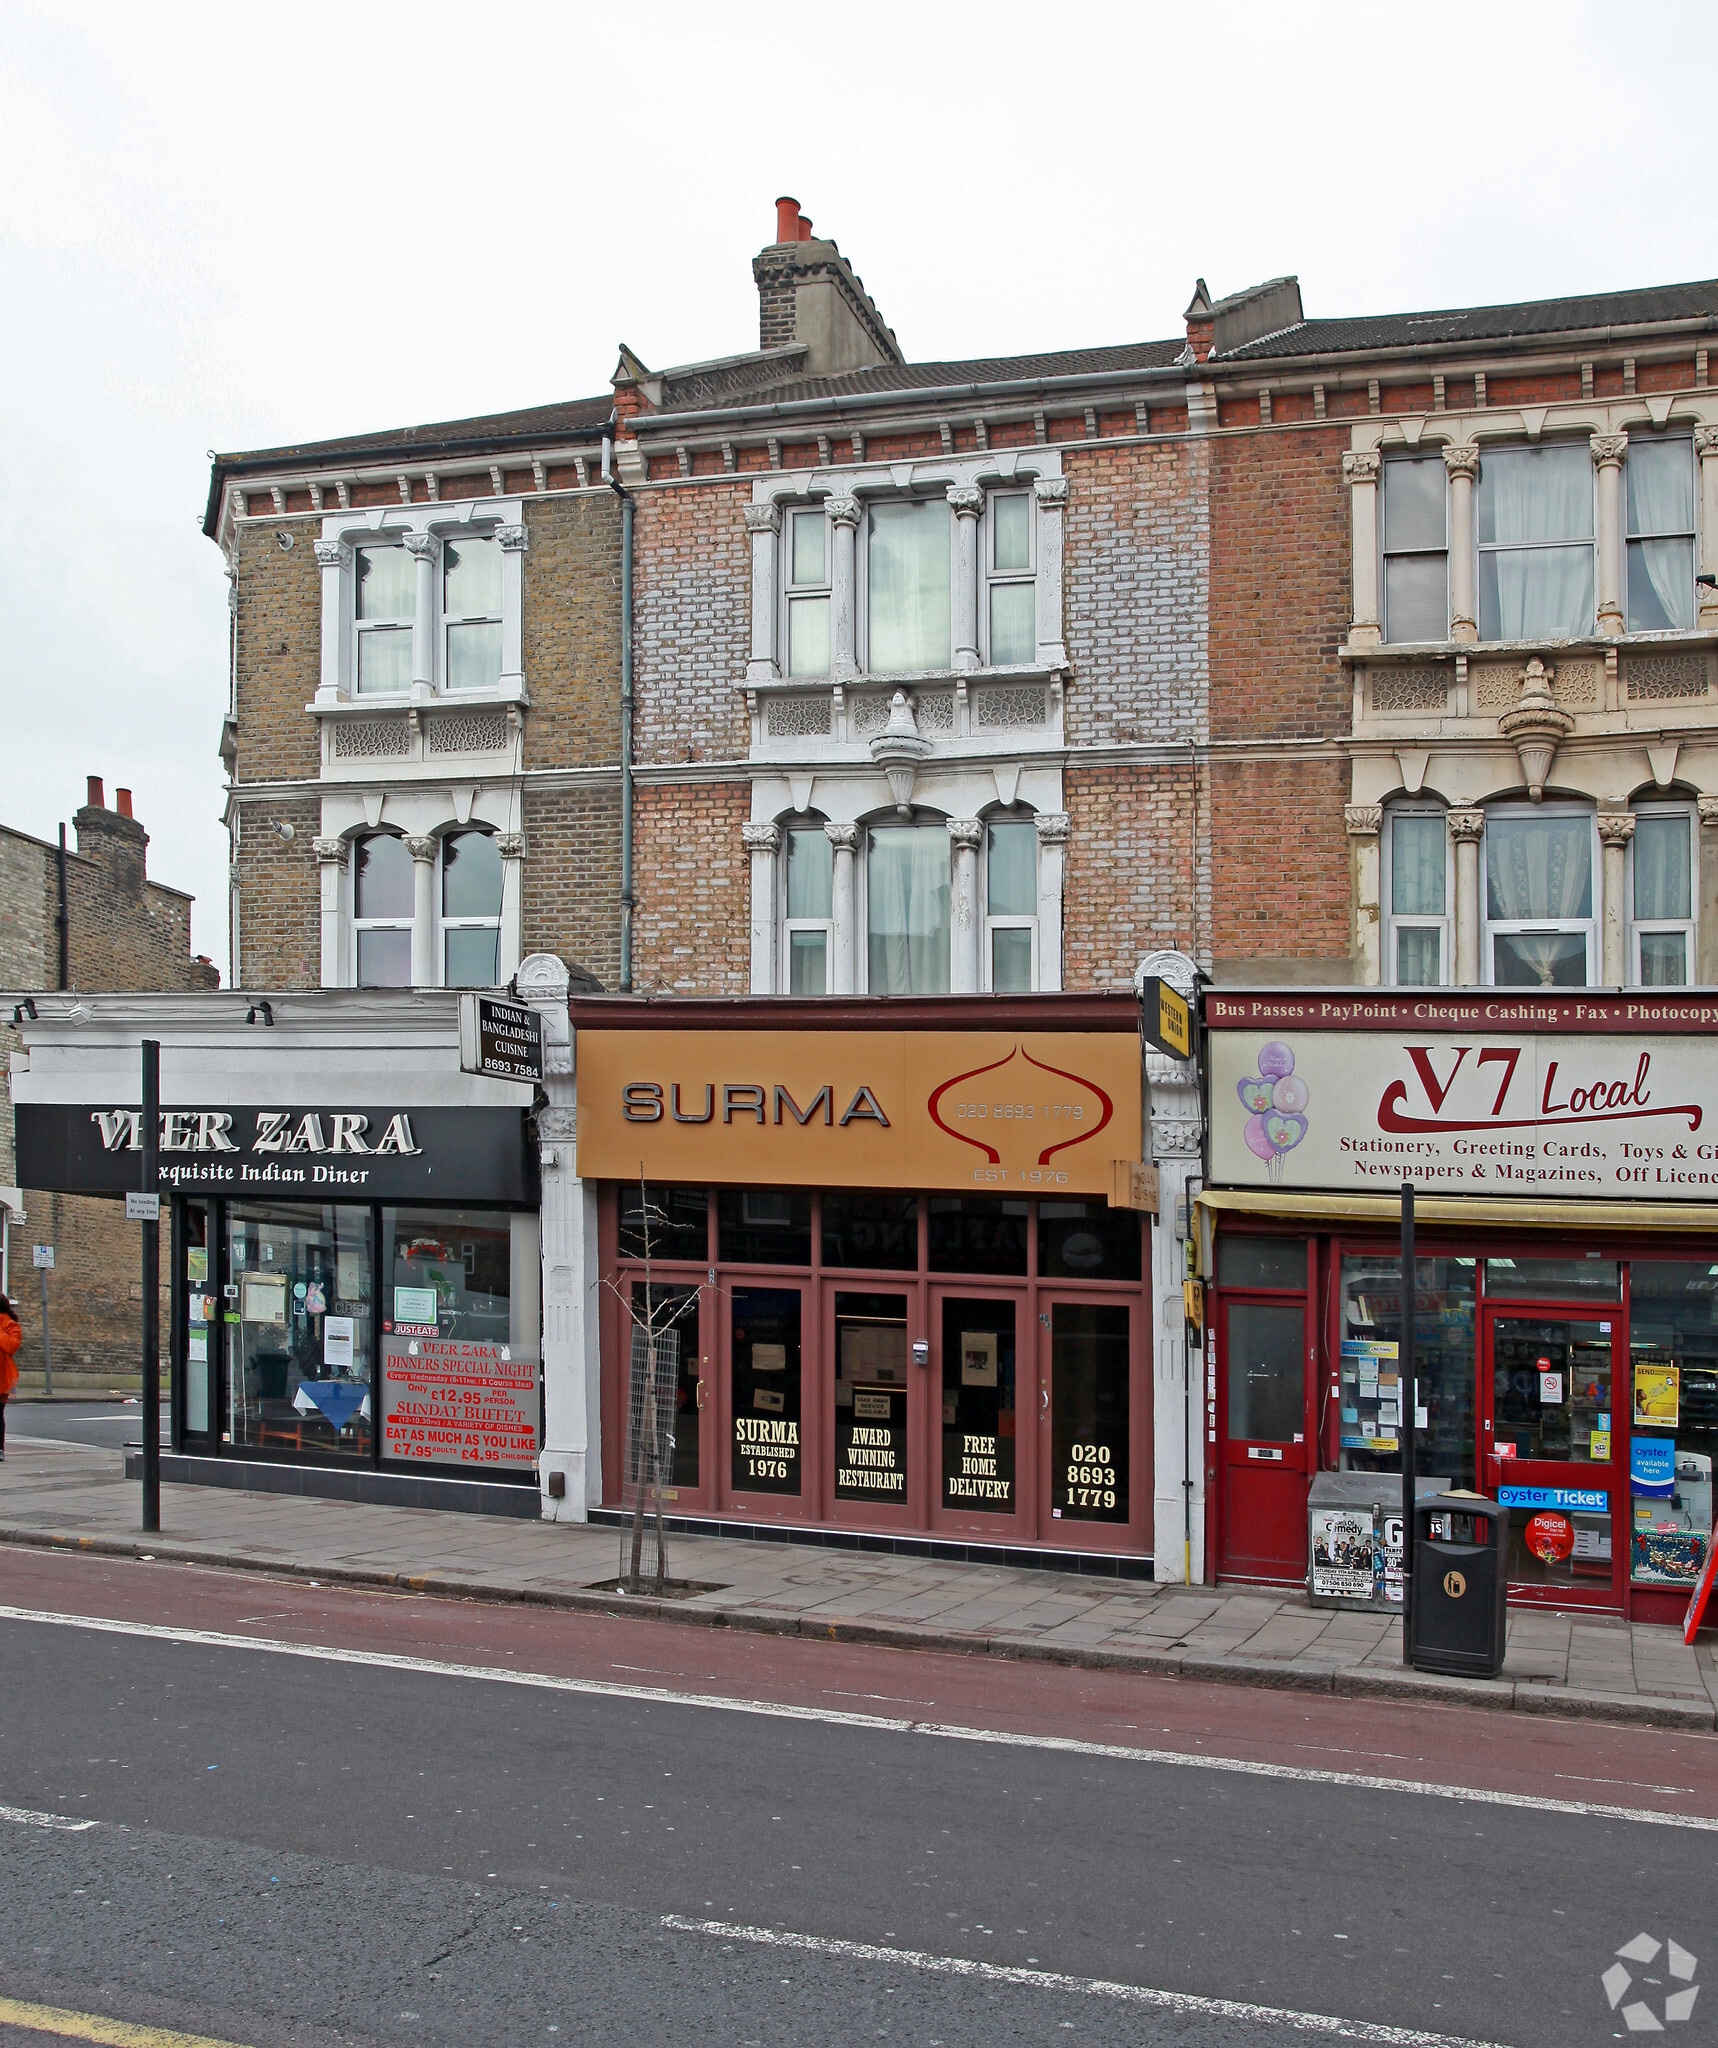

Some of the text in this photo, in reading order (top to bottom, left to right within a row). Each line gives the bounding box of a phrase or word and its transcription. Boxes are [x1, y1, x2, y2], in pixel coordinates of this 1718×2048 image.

[491, 1005, 530, 1026] INDIAN &
[1160, 998, 1182, 1025] WESTERN
[1215, 1002, 1718, 1024] Bus Passes PayPoint Cheque Cashing Fax Photocopy
[482, 1019, 539, 1044] BANGLADESHI
[1168, 1018, 1182, 1038] UNION
[495, 1040, 529, 1058] CUISINE
[484, 1057, 539, 1078] 8693 7584
[1402, 1047, 1651, 1116] V7 Local
[622, 1082, 891, 1128] SURMA
[957, 1104, 1083, 1120] 020 8693 1779
[252, 1112, 423, 1156] ZARA
[1340, 1136, 1440, 1158] Stationery,
[1453, 1139, 1536, 1160] Greeting
[1543, 1141, 1607, 1160] Cards,
[1620, 1143, 1664, 1162] Toys
[1671, 1143, 1688, 1159] &
[158, 1162, 370, 1187] xquisite Indian Diner
[1020, 1170, 1068, 1184] 1976
[1354, 1160, 1463, 1181] Newspapers
[1471, 1163, 1487, 1178] &
[1495, 1164, 1602, 1184] Magazines,
[1615, 1165, 1650, 1182] Off
[396, 1325, 416, 1334] JUST
[417, 1327, 433, 1335] EAT
[422, 1341, 498, 1359] VEER ZARA
[387, 1355, 535, 1378] DINNERS SPECIAL NIGHT
[1637, 1368, 1655, 1376] SEND
[389, 1372, 408, 1380] Every
[410, 1373, 448, 1383] Wednesday
[488, 1378, 513, 1387] Course
[515, 1379, 531, 1388] Meal
[408, 1383, 481, 1405] Only £12.95
[484, 1396, 515, 1406] PERSON
[492, 1389, 507, 1397] PER
[396, 1401, 525, 1423] SUNDAY BUFFET
[453, 1420, 483, 1429] VARIETY
[496, 1424, 523, 1432] DISHES
[736, 1418, 799, 1445] SURMA
[386, 1427, 536, 1450] EAT AS MUCH AS YOU LIKE
[852, 1427, 891, 1447] AWARD
[963, 1435, 996, 1455] FREE
[394, 1442, 535, 1462] £7.95 ADULTS £4.95 CHILDREN
[740, 1444, 795, 1459] ESTABLISHED
[847, 1448, 895, 1468] WINNING
[1071, 1444, 1111, 1464] 020
[1635, 1448, 1668, 1458] oyster
[749, 1459, 787, 1478] 1976
[962, 1456, 997, 1476] HOME
[1636, 1459, 1669, 1468] available
[1643, 1466, 1660, 1475] here
[839, 1469, 904, 1490] RESTAURANT
[1067, 1465, 1115, 1486] 8693
[949, 1477, 1010, 1499] DELIVERY
[1067, 1487, 1116, 1508] 1779
[1501, 1489, 1605, 1506] oyster Ticket
[1325, 1522, 1363, 1536] Cmedy
[1534, 1517, 1566, 1530] Digicel
